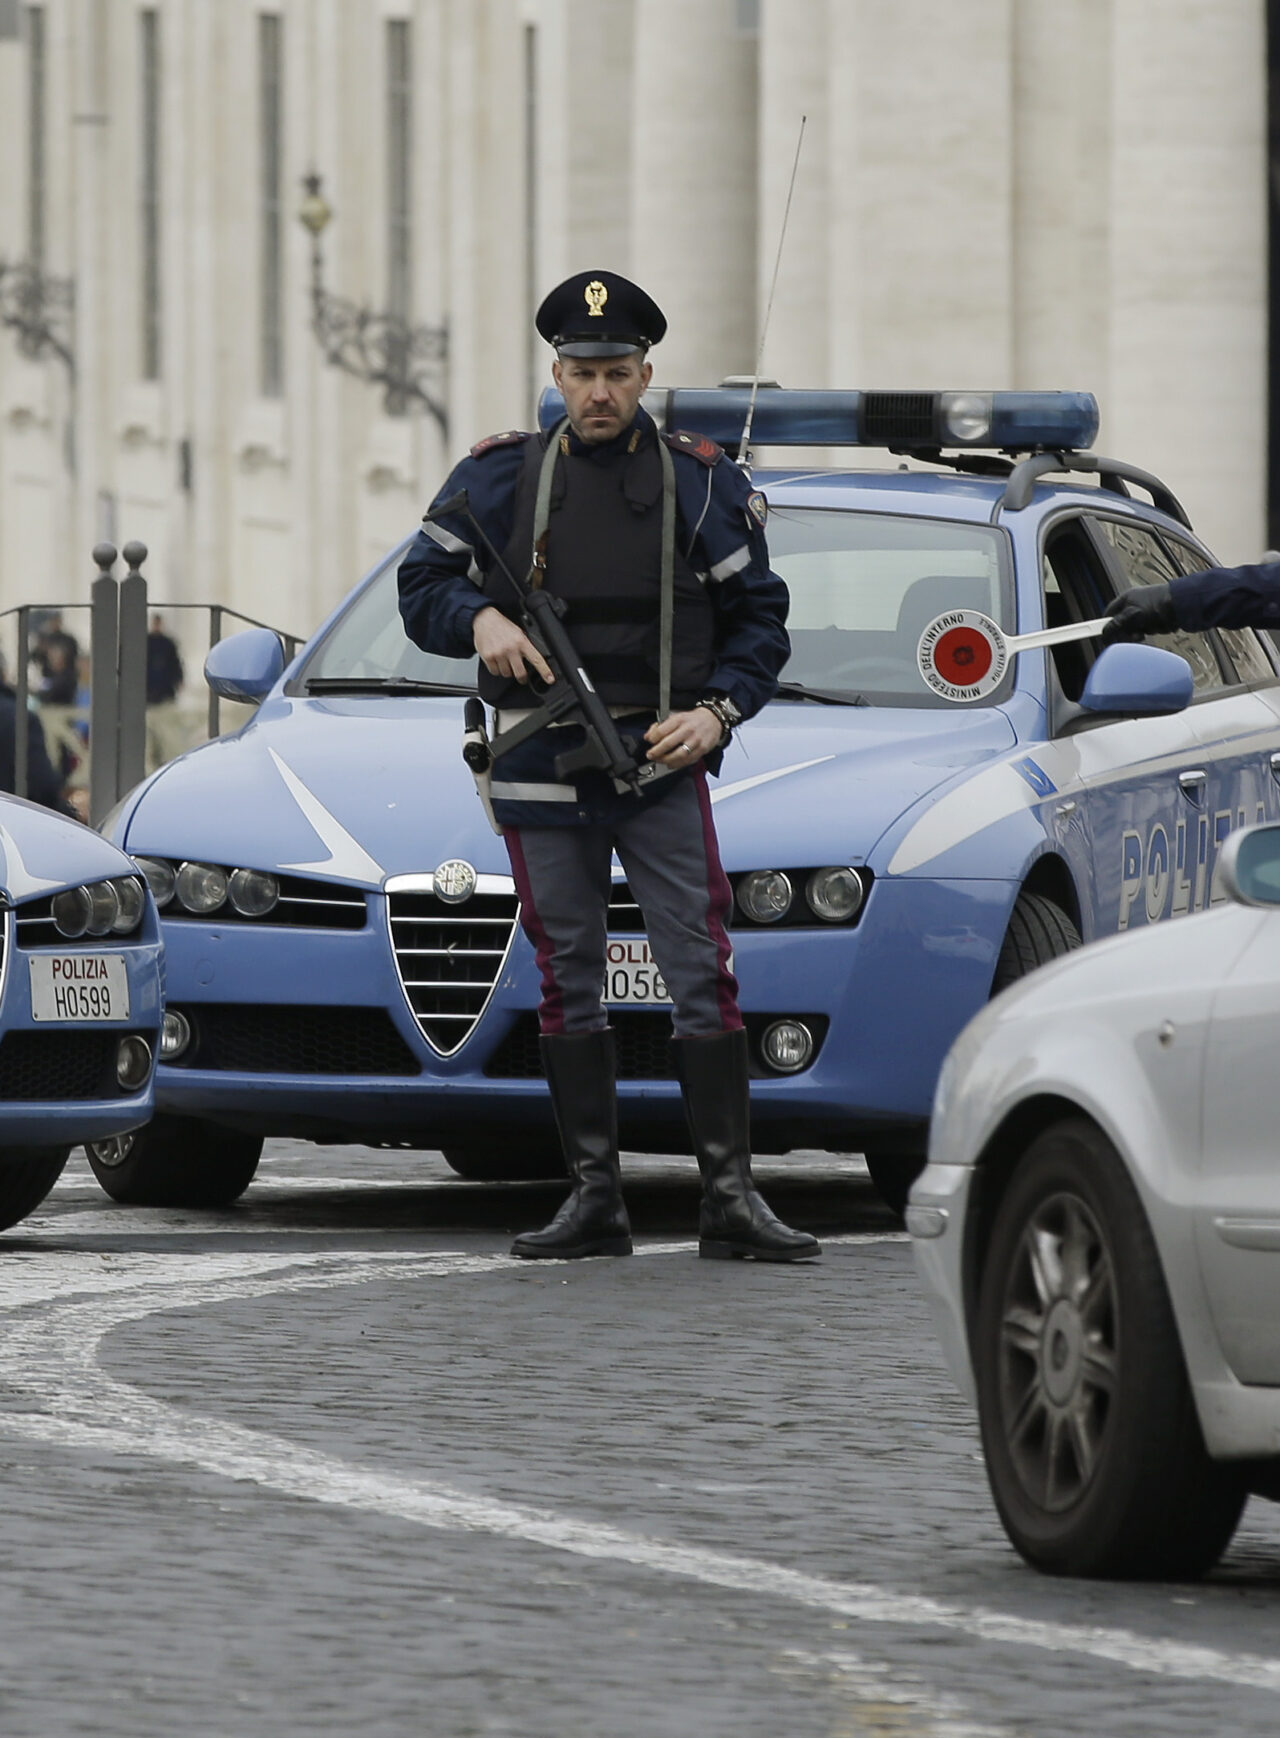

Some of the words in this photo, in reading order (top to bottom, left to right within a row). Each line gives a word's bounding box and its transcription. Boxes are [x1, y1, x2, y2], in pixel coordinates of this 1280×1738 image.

[921, 613, 964, 670] DELL'INTERNO
[928, 673, 980, 699] MINISTERO
[1118, 801, 1266, 931] POLIZ
[52, 958, 108, 979] POLIZIA
[607, 943, 655, 964] OLI
[604, 969, 669, 999] 056
[54, 986, 111, 1017] H0599
